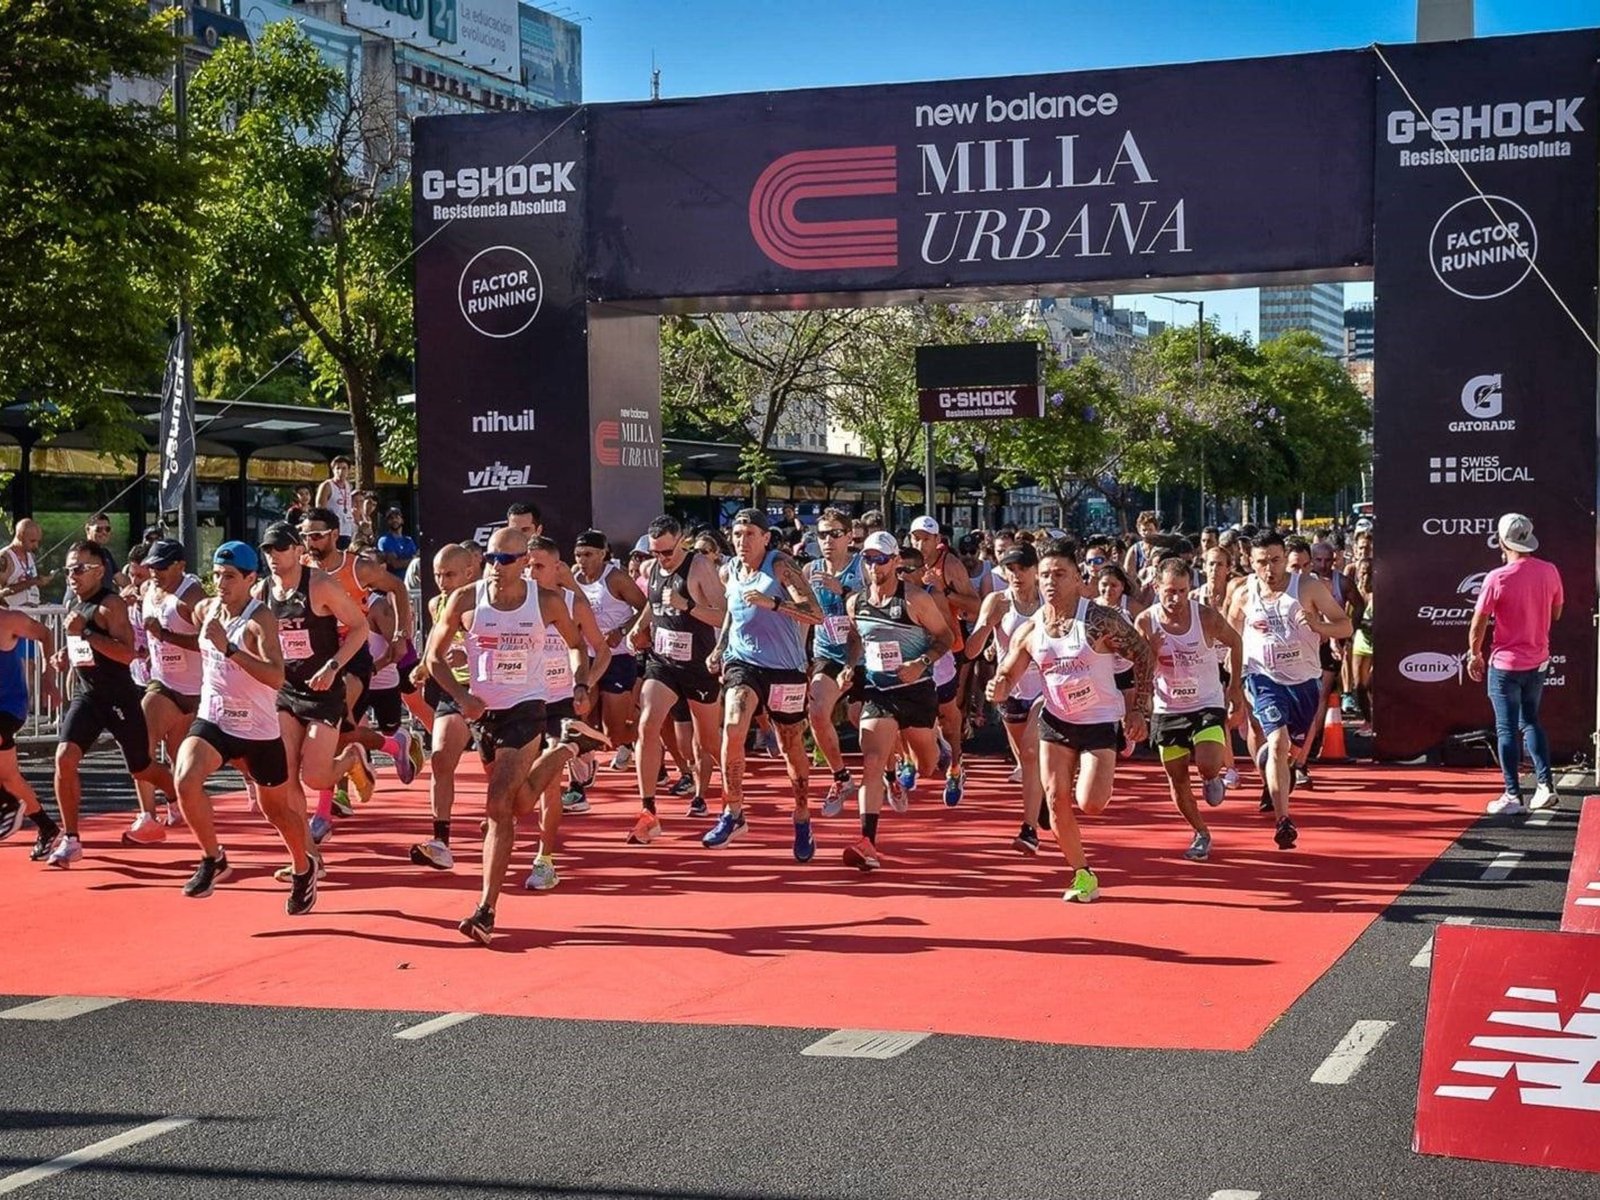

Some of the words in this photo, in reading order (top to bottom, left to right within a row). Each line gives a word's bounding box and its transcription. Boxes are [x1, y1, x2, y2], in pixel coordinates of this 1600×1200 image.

[916, 99, 978, 127] new
[986, 92, 1118, 123] balance
[1387, 97, 1585, 144] G-SHOCK
[917, 130, 1158, 196] MILLA
[1400, 145, 1496, 167] Resistencia
[1498, 141, 1572, 160] Absoluta
[422, 161, 576, 200] G-SHOCK
[433, 203, 508, 220] Resistencia
[510, 199, 567, 216] Absoluta
[920, 198, 1193, 265] URBANA
[1447, 222, 1520, 250] FACTOR
[1441, 241, 1530, 272] RUNNING
[472, 270, 529, 295] FACTOR
[468, 287, 537, 315] RUNNING
[939, 390, 1018, 408] G-SHOCK
[472, 410, 535, 432] nihuil
[621, 422, 654, 443] MILLA
[1448, 420, 1516, 432] GATORADE
[1461, 456, 1500, 468] SWISS
[1461, 467, 1535, 482] MEDICAL
[1404, 661, 1450, 673] Granix
